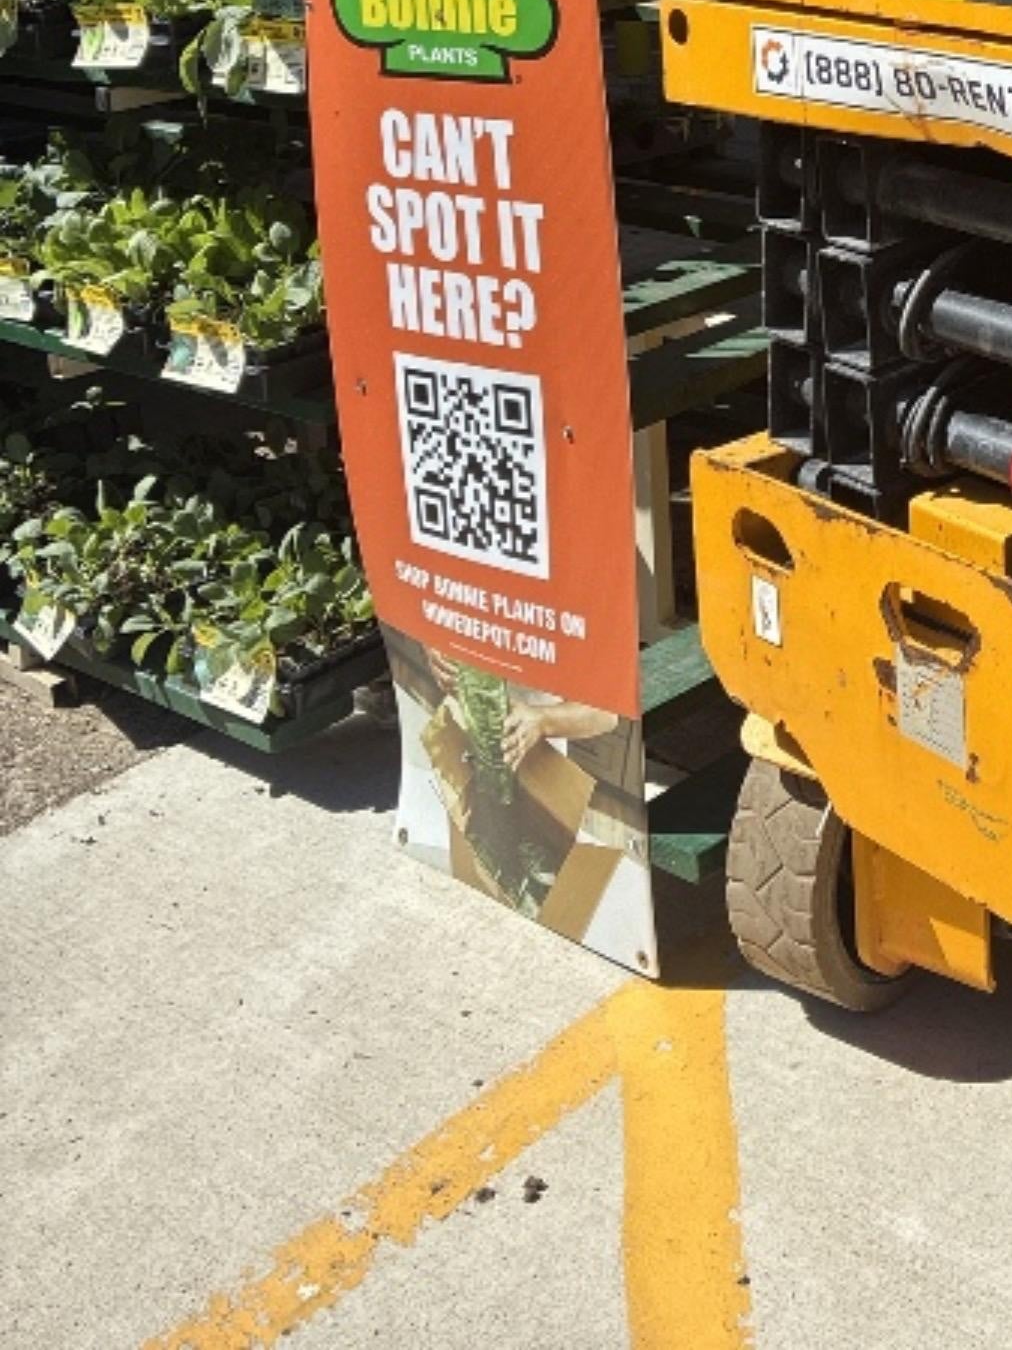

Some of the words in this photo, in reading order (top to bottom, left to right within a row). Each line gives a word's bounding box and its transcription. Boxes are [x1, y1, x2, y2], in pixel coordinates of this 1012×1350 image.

[407, 43, 478, 67] PLANTS
[805, 50, 883, 96] (888)
[379, 107, 514, 190] CAN'T
[366, 183, 487, 266] SPOT
[497, 200, 545, 274] IT
[386, 262, 537, 349] HERE?
[491, 593, 556, 631] PLANTS
[560, 611, 586, 640] ON
